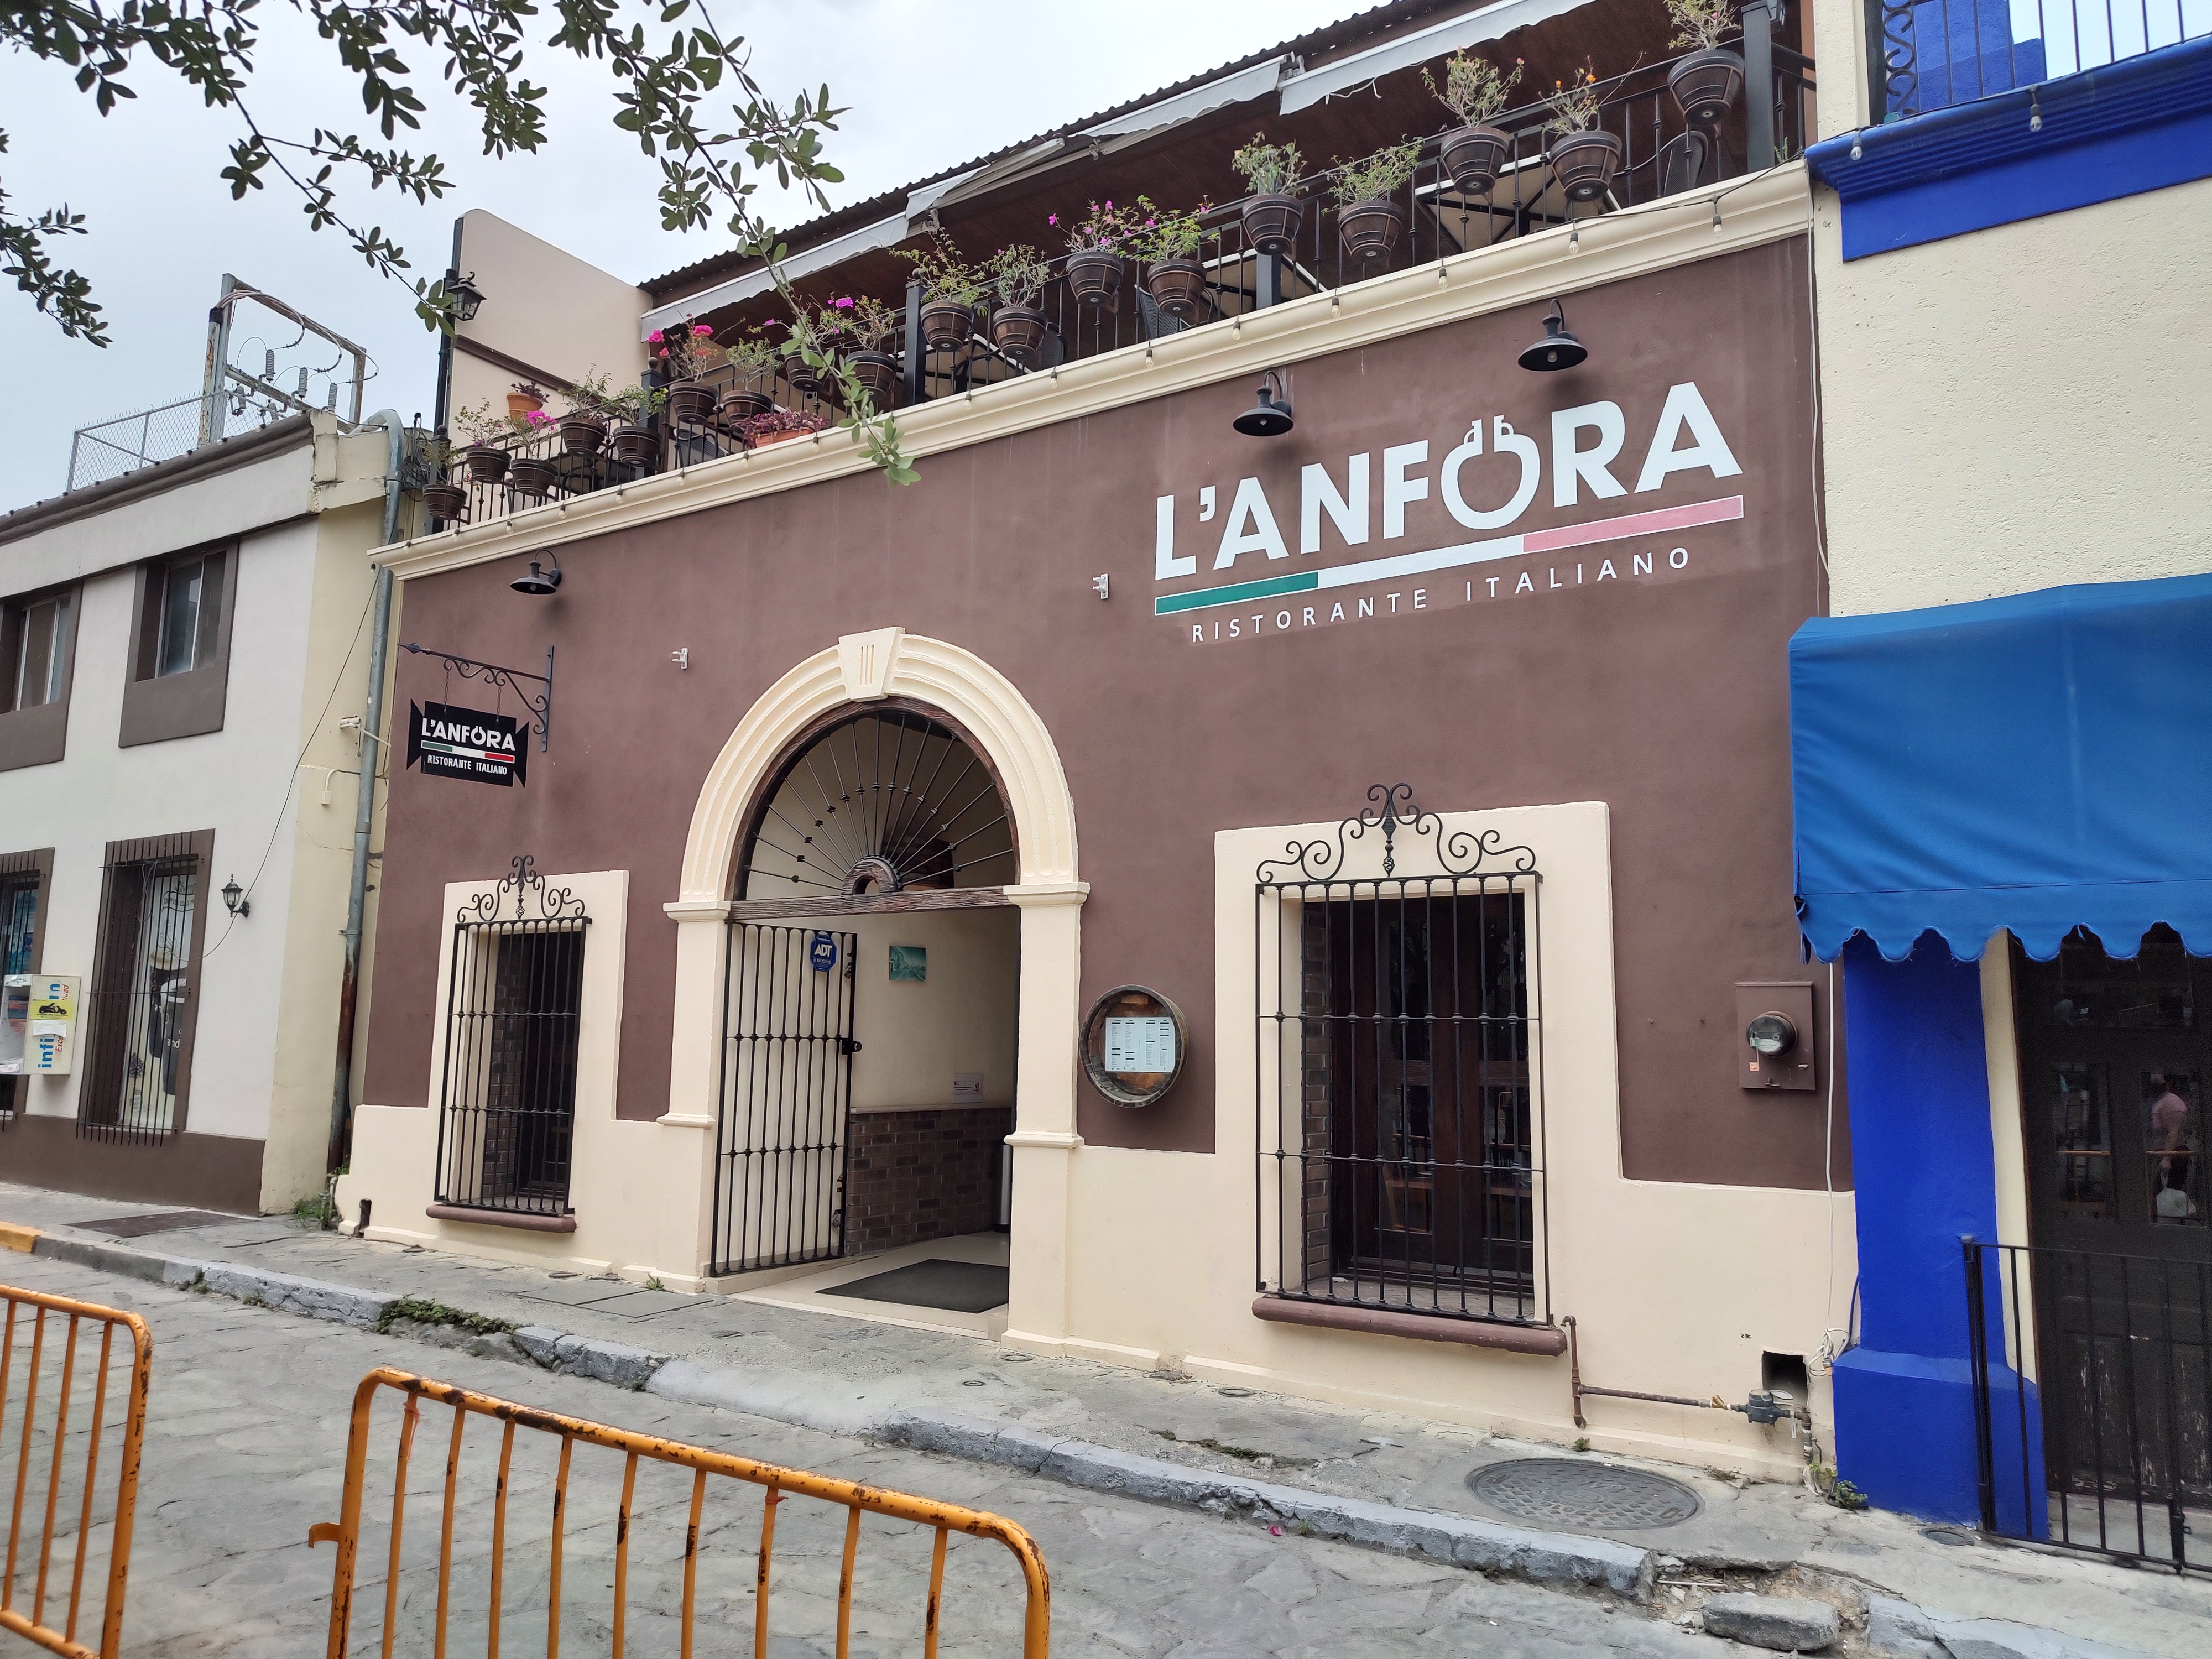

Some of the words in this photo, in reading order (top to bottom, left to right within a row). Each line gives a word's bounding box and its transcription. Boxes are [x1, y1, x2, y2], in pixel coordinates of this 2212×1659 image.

[1192, 588, 1427, 643] RISTORANTE
[1466, 547, 1689, 602] ITALIANO
[427, 754, 472, 770] RISTORANTE
[476, 761, 508, 775] ITALIANO
[814, 943, 833, 958] ADT
